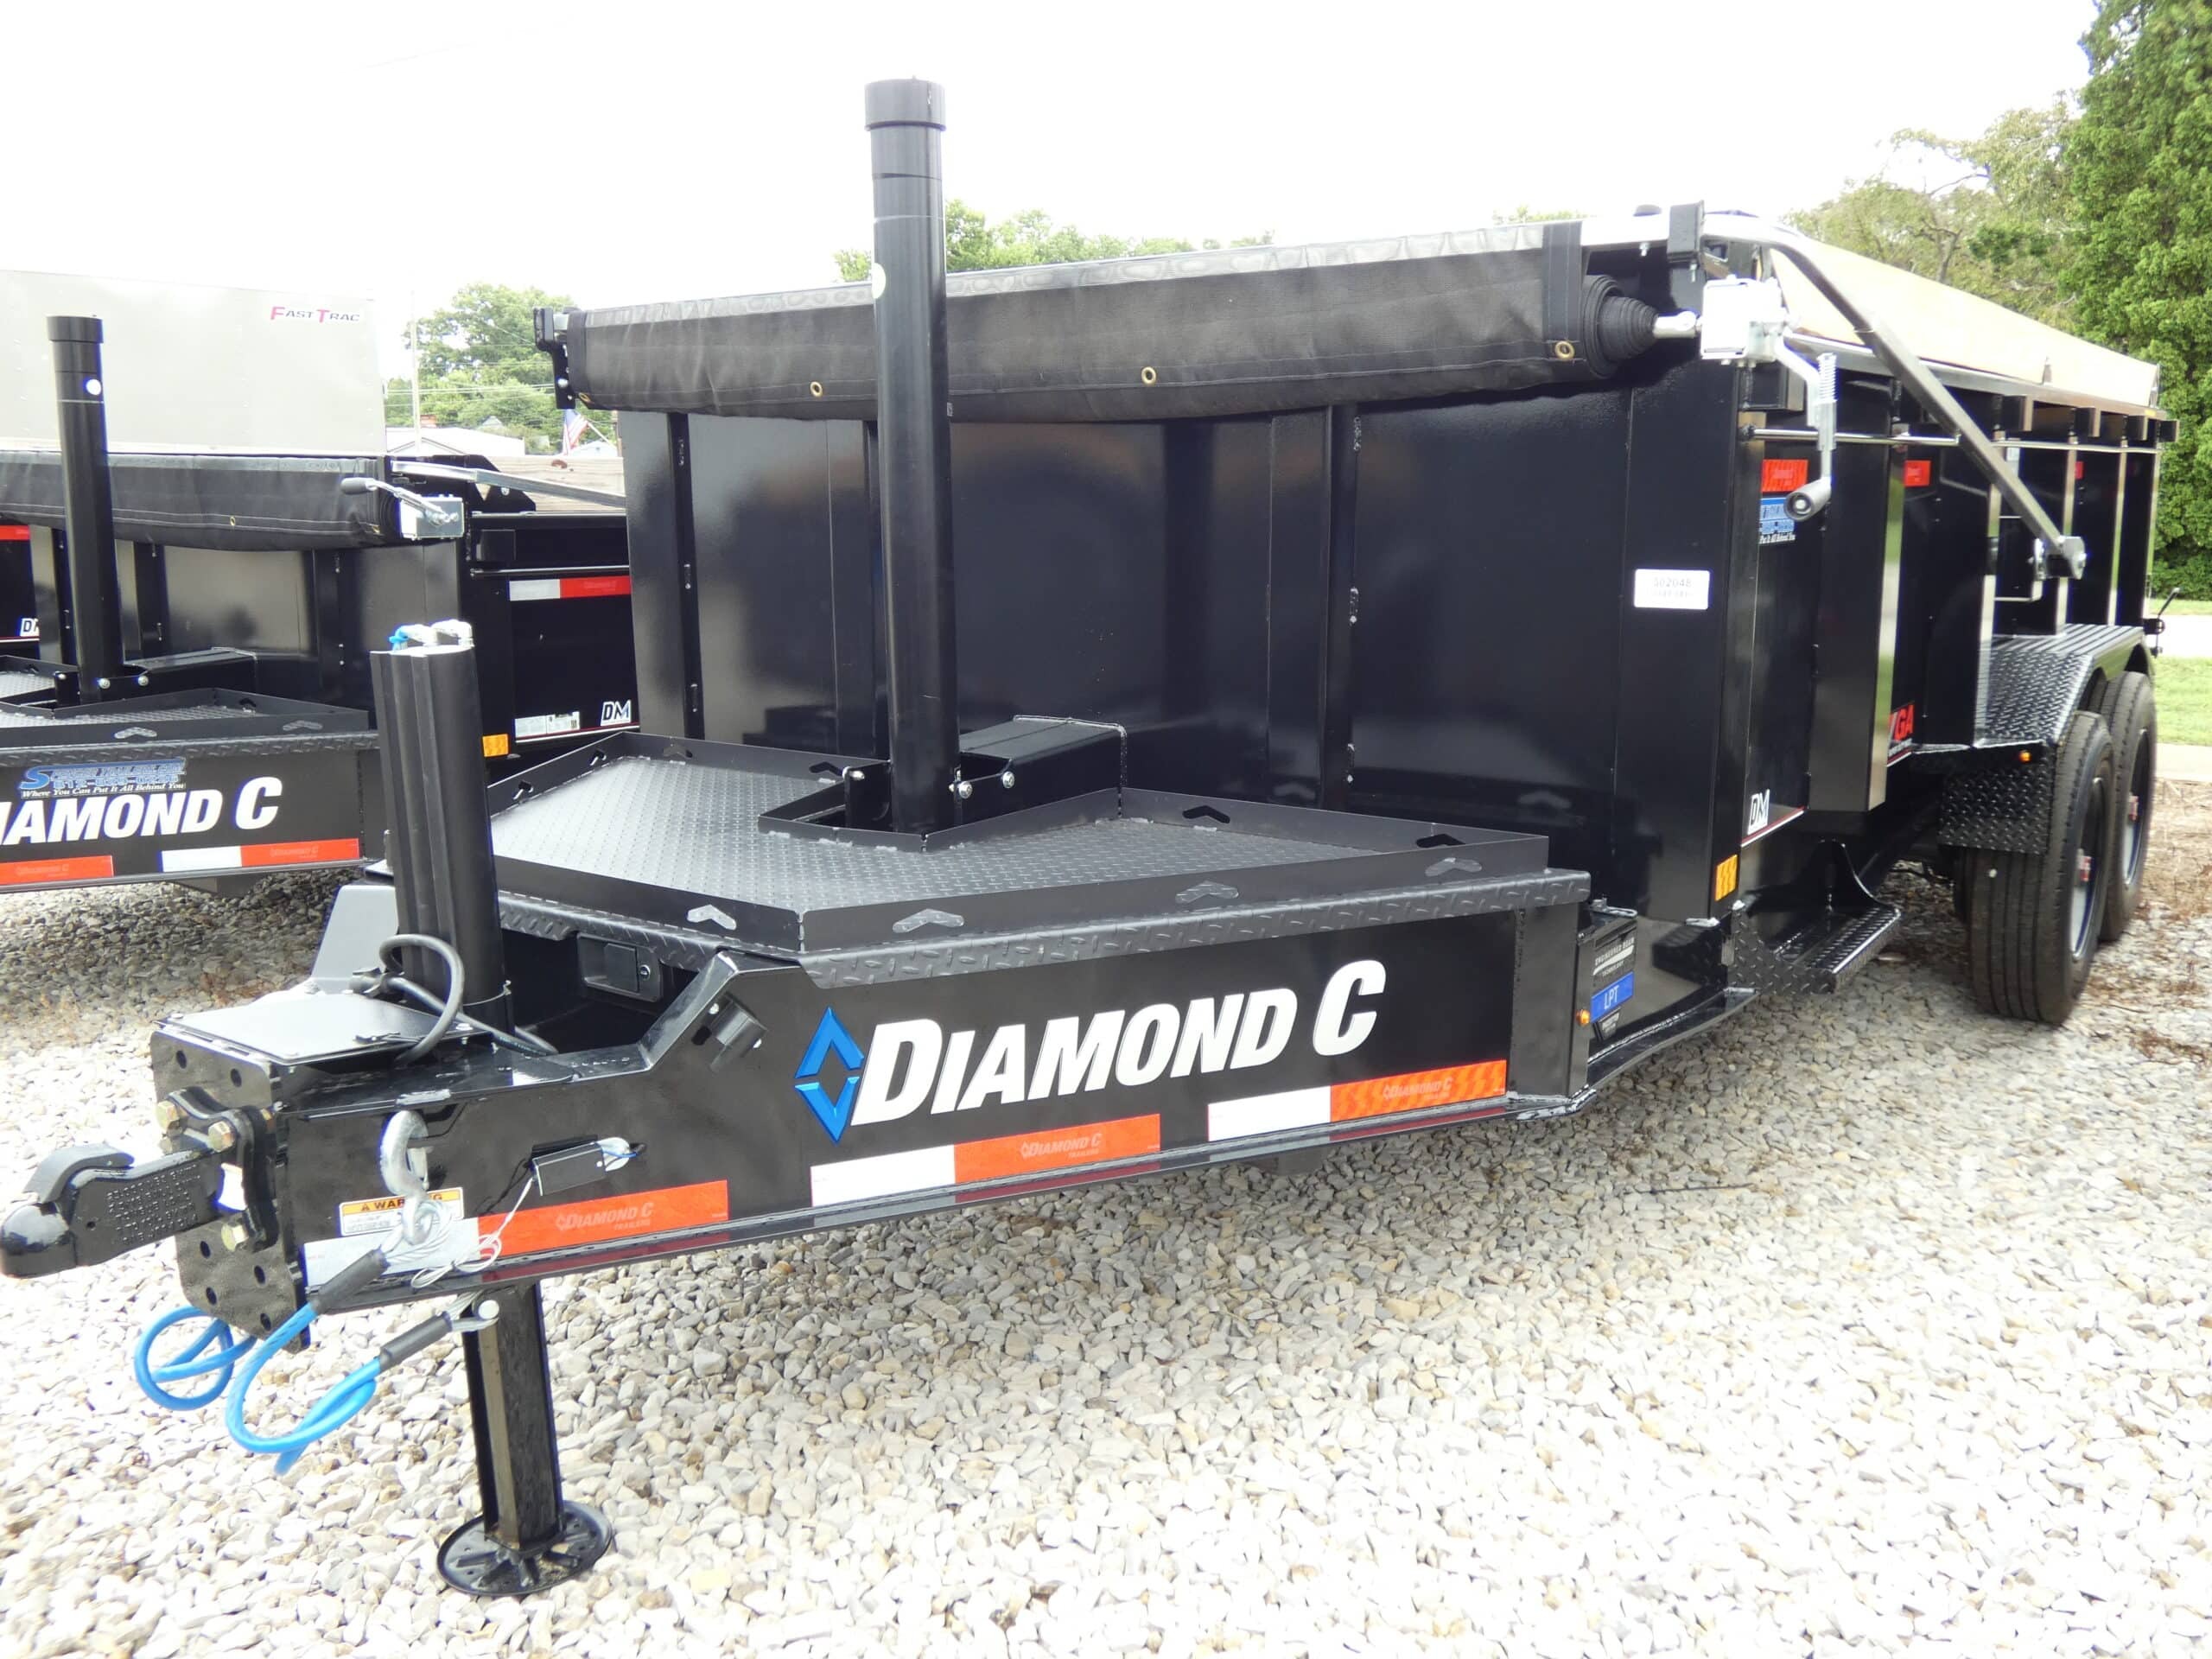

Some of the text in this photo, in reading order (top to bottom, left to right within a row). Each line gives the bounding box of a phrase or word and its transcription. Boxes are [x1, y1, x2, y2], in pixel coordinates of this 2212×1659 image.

[270, 306, 360, 323] FAST TRAC
[22, 789, 51, 798] Where
[54, 787, 70, 796] You
[72, 786, 92, 795] Can
[93, 785, 109, 794] Put
[136, 782, 167, 791] Behind
[235, 777, 283, 830] C
[850, 960, 1386, 1126] DIAMOND C
[374, 1193, 443, 1211] WARG
[564, 1202, 654, 1230] DIAMOND C
